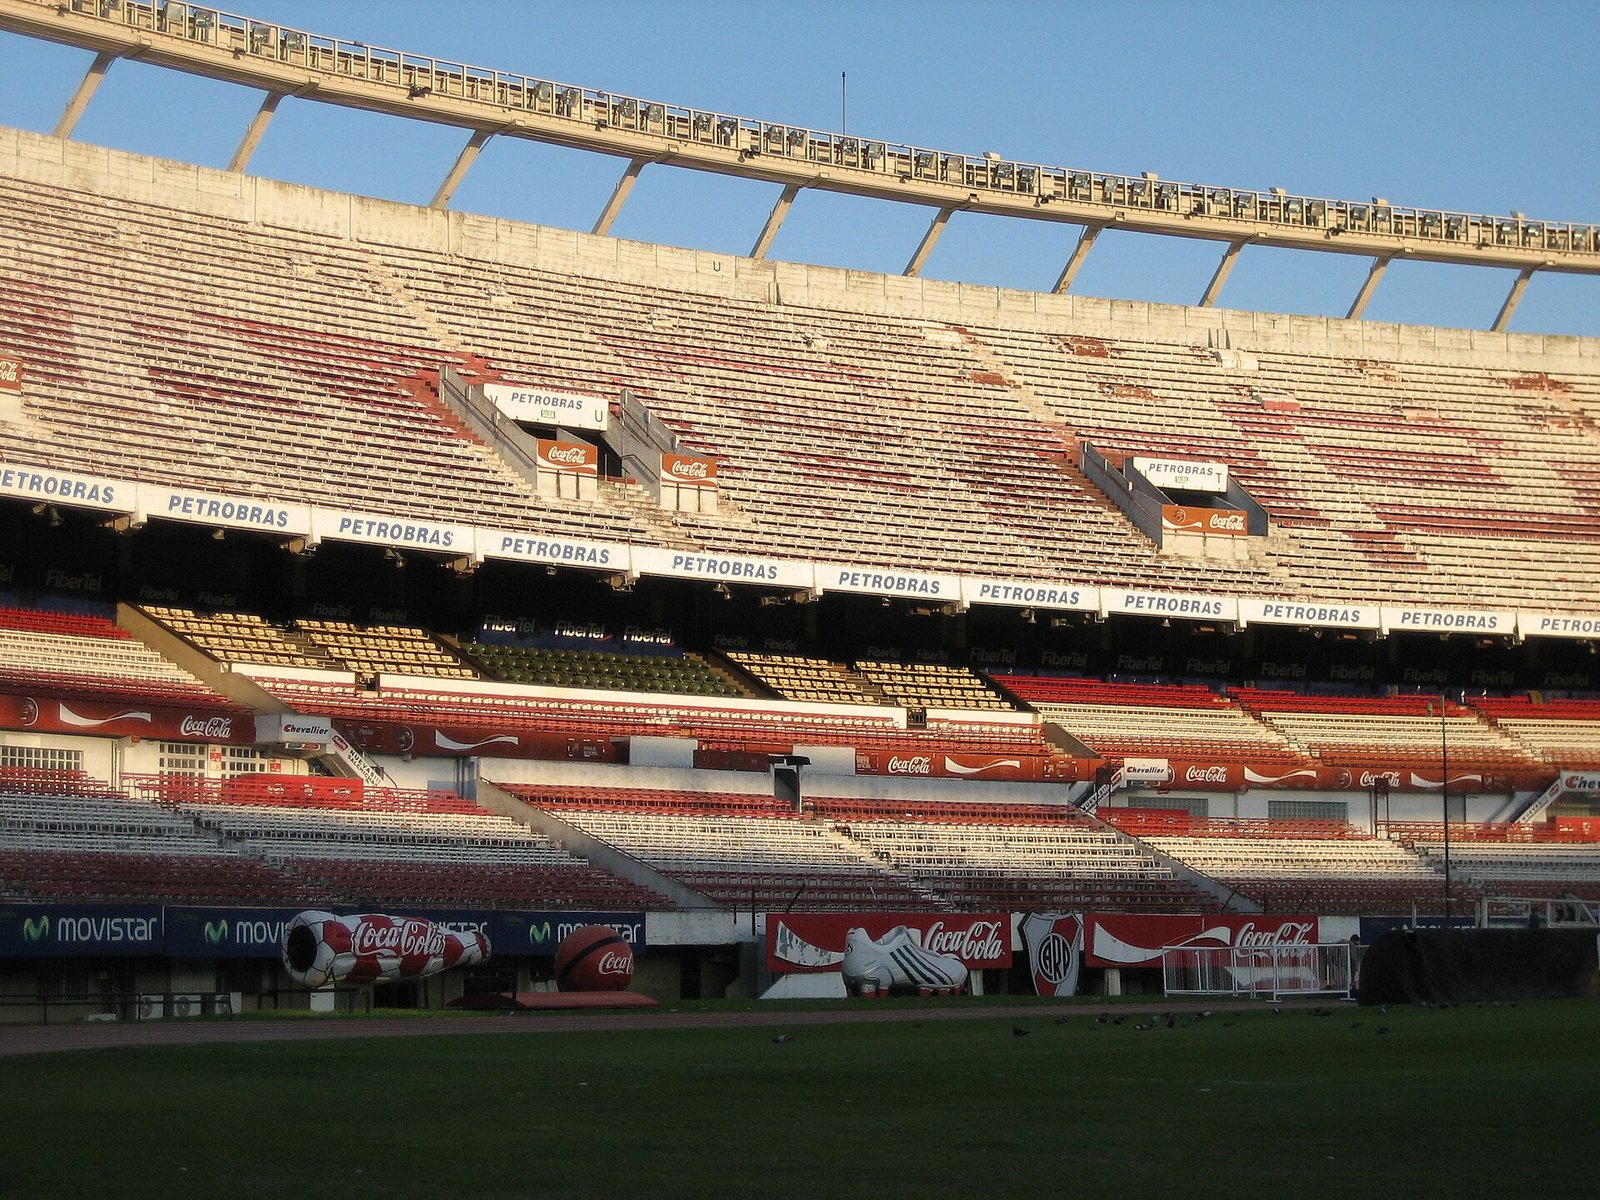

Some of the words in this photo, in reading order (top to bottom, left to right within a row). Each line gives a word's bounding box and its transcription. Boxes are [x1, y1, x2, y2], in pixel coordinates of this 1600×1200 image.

[713, 261, 721, 272] U
[1271, 319, 1278, 329] T
[511, 392, 583, 411] PETROBRAS
[594, 409, 603, 424] U
[1148, 463, 1214, 477] PETROBRAS
[1215, 473, 1223, 485] T
[168, 494, 290, 528] PETROBRAS
[338, 517, 454, 548] PETROBRAS
[500, 536, 611, 565] PETROBRAS
[671, 555, 778, 580] PETROBRAS
[46, 568, 103, 591] FiberTel
[838, 571, 941, 595] PETROBRAS
[139, 585, 181, 602] FiberTel
[198, 590, 238, 607] FiberTel
[979, 584, 1080, 606] PETROBRAS
[312, 602, 351, 617] FiberTel
[1124, 595, 1223, 616] PETROBRAS
[1262, 604, 1361, 623] PETROBRAS
[369, 607, 408, 622] FiberTel
[482, 613, 536, 633] FiberTel
[1400, 611, 1498, 629] PETROBRAS
[554, 619, 606, 640] FiberTel
[622, 624, 673, 645] FiberTel
[714, 633, 749, 648] FiberTel
[763, 638, 798, 652] FiberTel
[969, 647, 1017, 664] FiberTel
[1040, 650, 1088, 668] FiberTel
[1117, 654, 1164, 671] FiberTel
[1187, 657, 1232, 674] FiberTel
[1260, 661, 1306, 679] FiberTel
[1330, 664, 1375, 680] FiberTel
[1403, 667, 1448, 683] FiberTel
[1471, 670, 1515, 685] FiberTel
[284, 723, 329, 736] Chevallier
[1127, 765, 1165, 775] Chevallier
[57, 916, 158, 942] movistar
